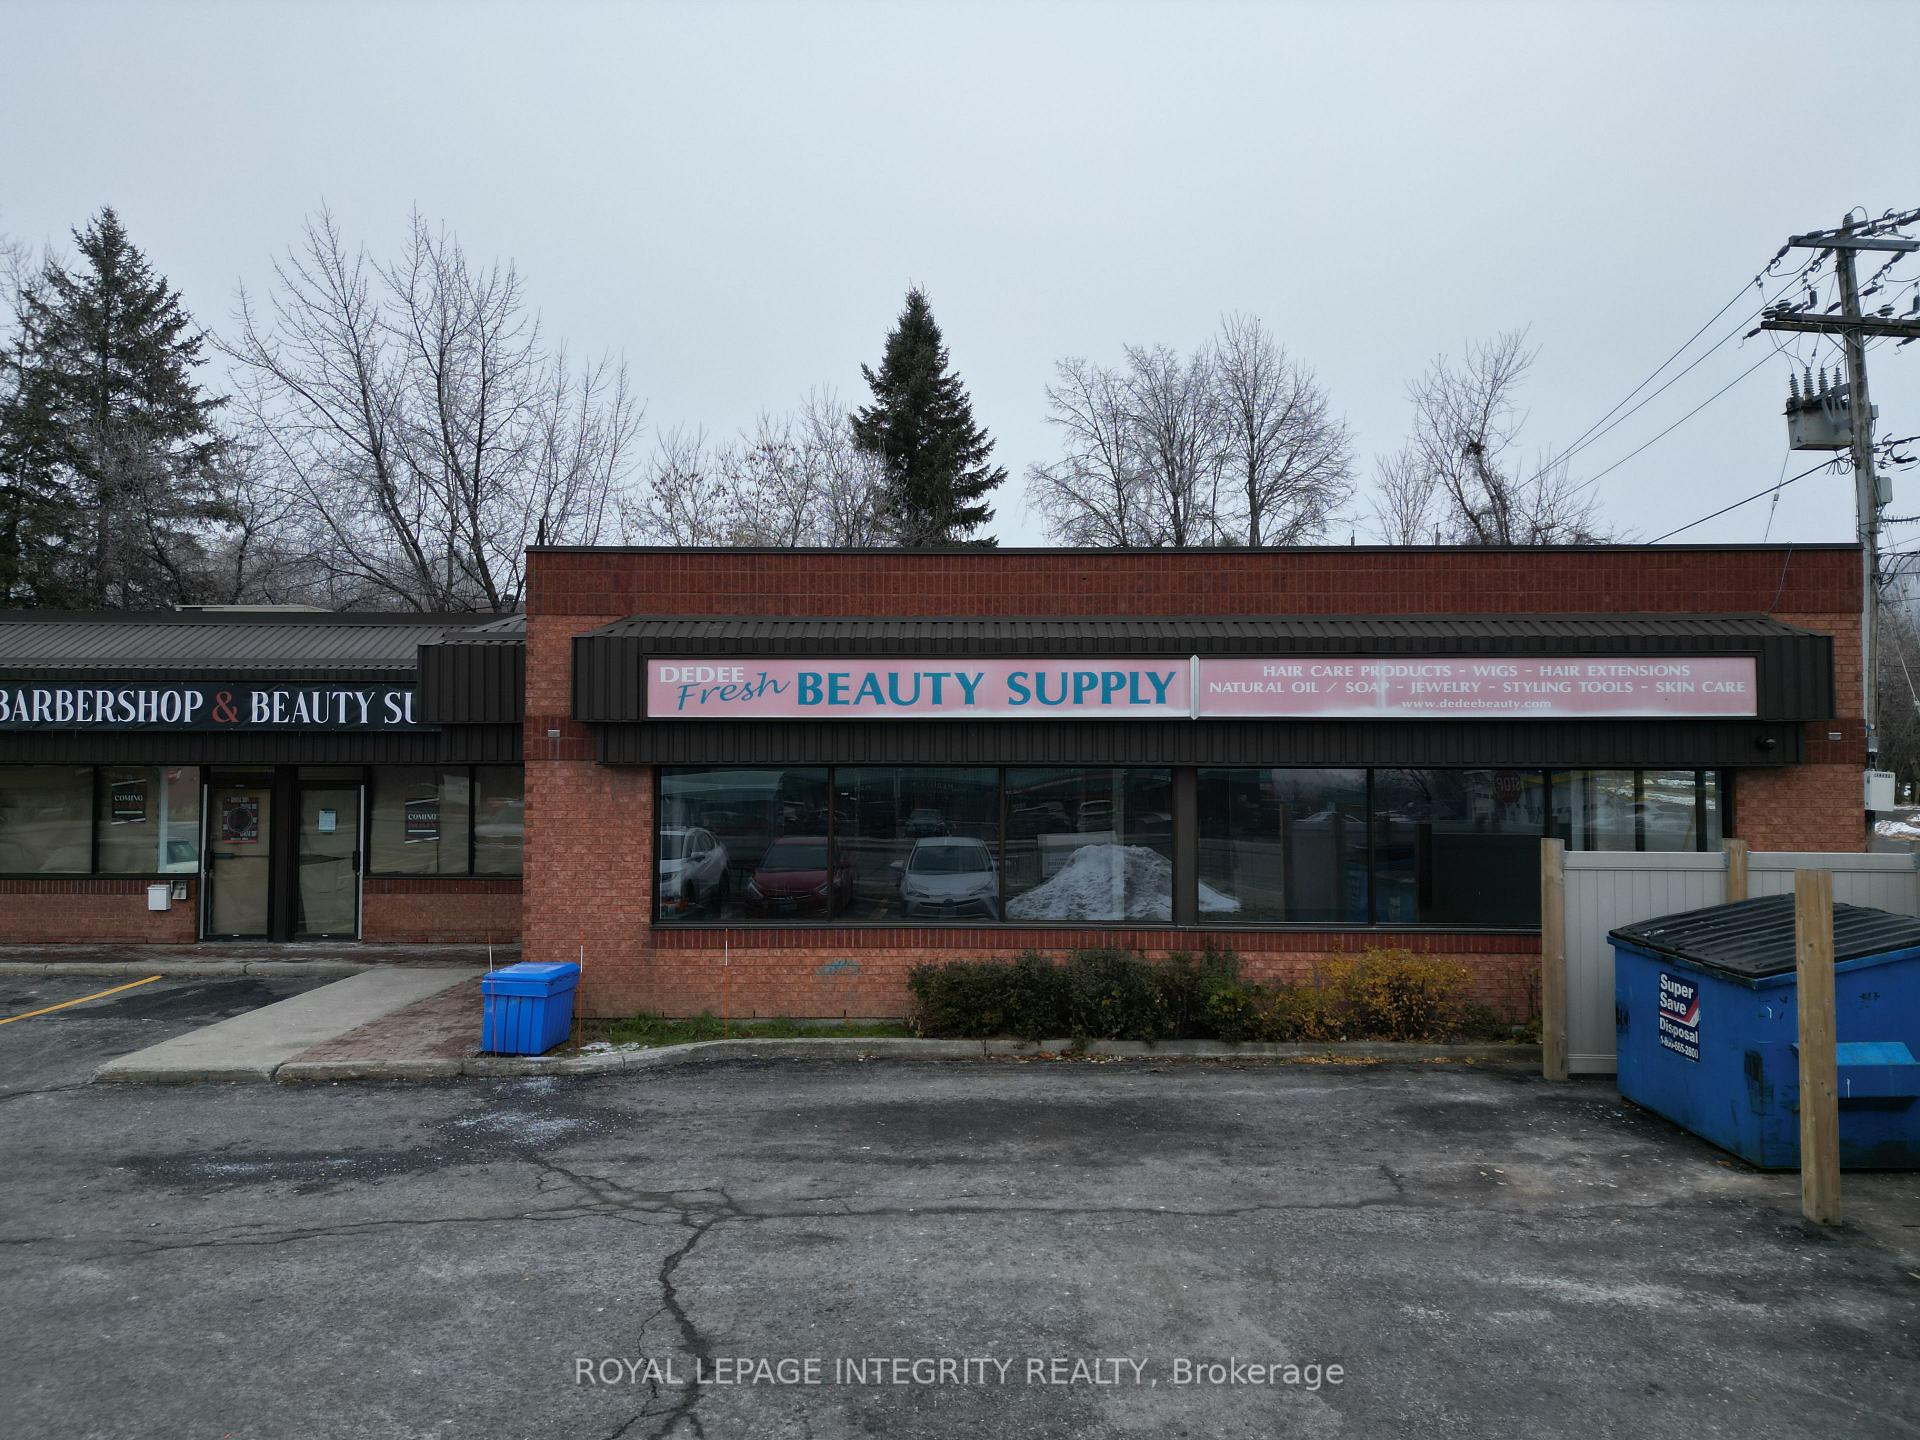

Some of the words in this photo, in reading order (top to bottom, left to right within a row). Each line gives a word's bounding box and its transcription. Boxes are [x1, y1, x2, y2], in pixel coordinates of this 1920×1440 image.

[660, 666, 744, 683] DEDEE
[1263, 666, 1303, 677] HAIR
[1310, 665, 1353, 677] CARE
[1361, 665, 1452, 677] PRODUCTS
[1473, 665, 1518, 677] WIGS
[1540, 665, 1580, 677] HAIR
[1588, 665, 1691, 677] EXTENSIONS
[677, 672, 791, 710] Fresh
[797, 672, 984, 706] BEAUTY
[1006, 671, 1176, 706] SUPPLY
[1209, 682, 1285, 693] NATURAL
[1291, 682, 1319, 693] OIL
[1326, 682, 1337, 693] /
[1344, 682, 1390, 693] SOAP
[1410, 682, 1481, 695] JEWELRY
[1503, 681, 1572, 693] STYLING
[1578, 681, 1633, 693] TOOLS
[1656, 681, 1695, 693] SKIN
[1702, 681, 1745, 693] CARE
[211, 691, 241, 723] &
[250, 691, 375, 724] BEAUTY
[1402, 699, 1552, 711] www.dedeebeauty.com
[1660, 973, 1694, 999] Super
[1659, 991, 1687, 1016] Save
[1659, 1017, 1698, 1044] Disposal
